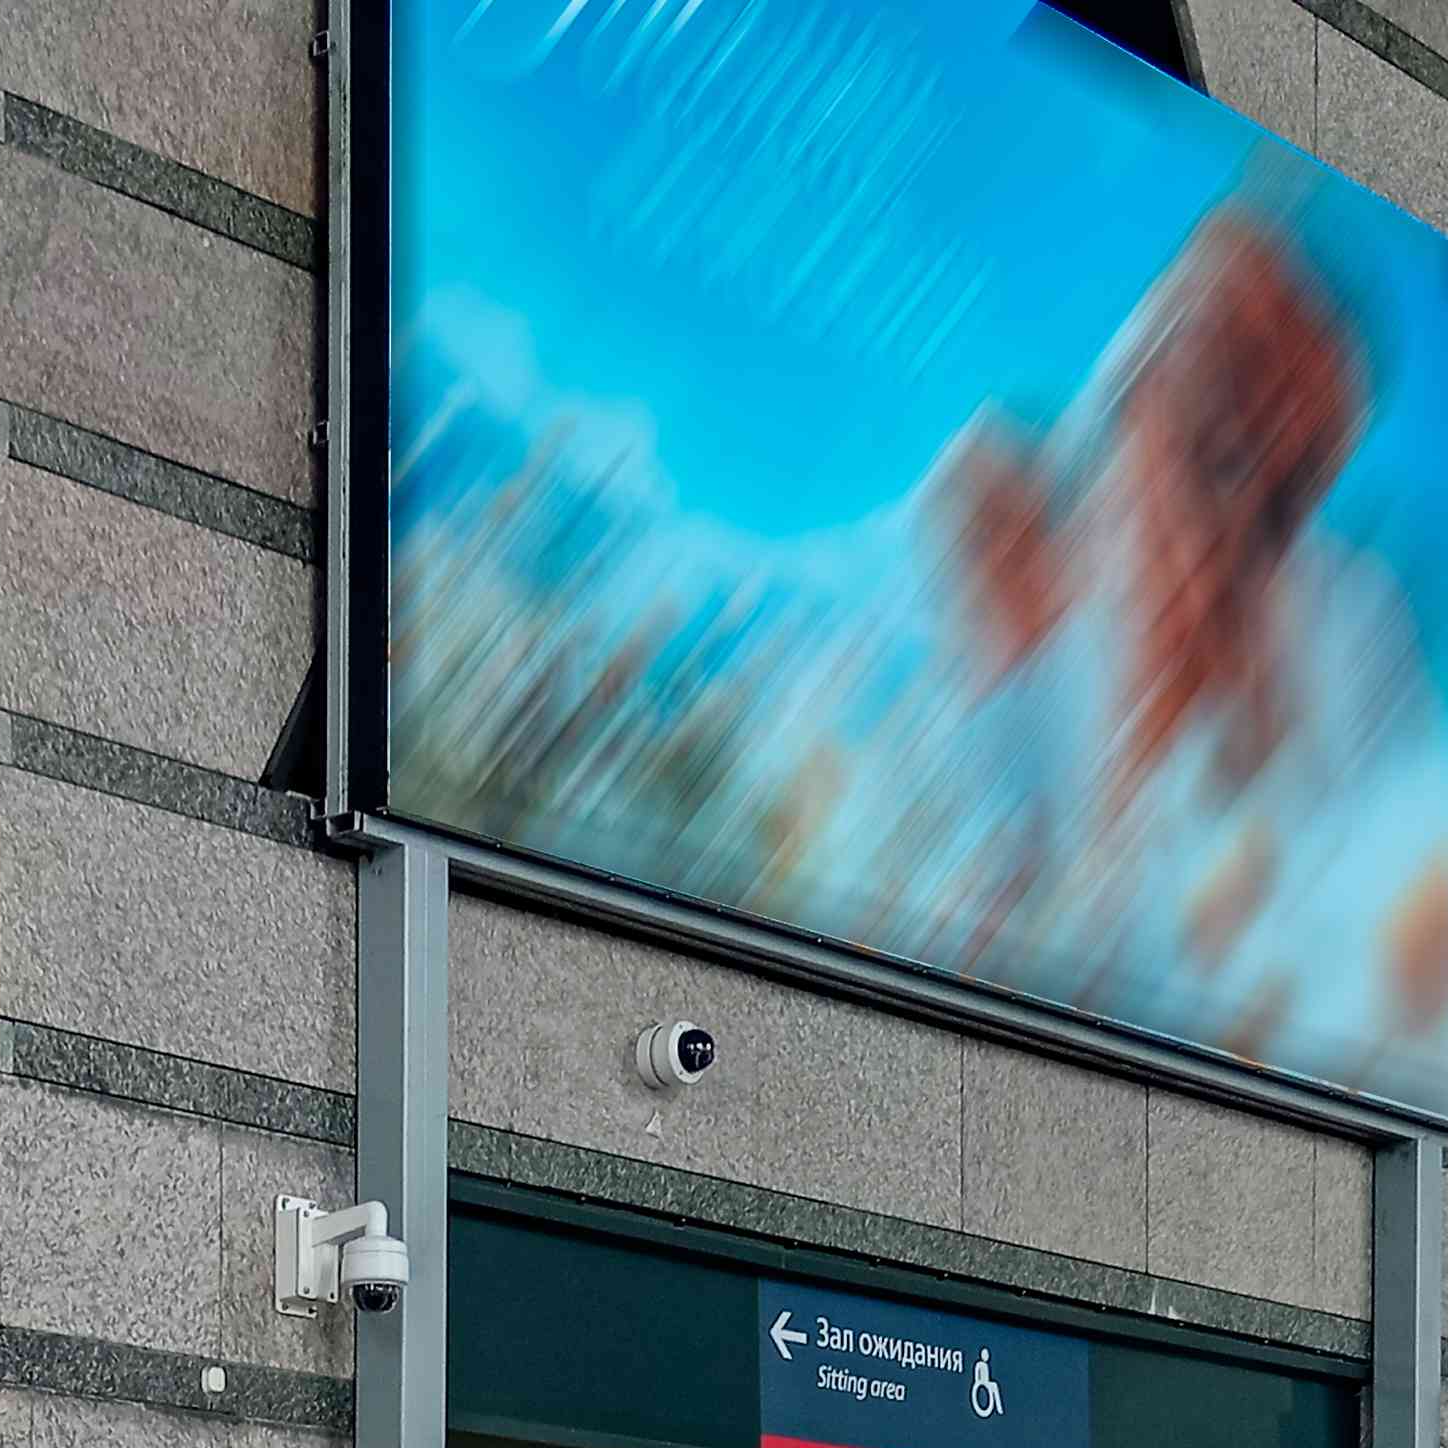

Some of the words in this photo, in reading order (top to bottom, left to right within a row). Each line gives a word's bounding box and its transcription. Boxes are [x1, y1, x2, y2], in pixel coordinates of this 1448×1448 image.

[815, 1316, 855, 1353] Зал
[859, 1332, 964, 1374] ожидания
[816, 1364, 867, 1402] Sitting
[869, 1379, 906, 1401] area
